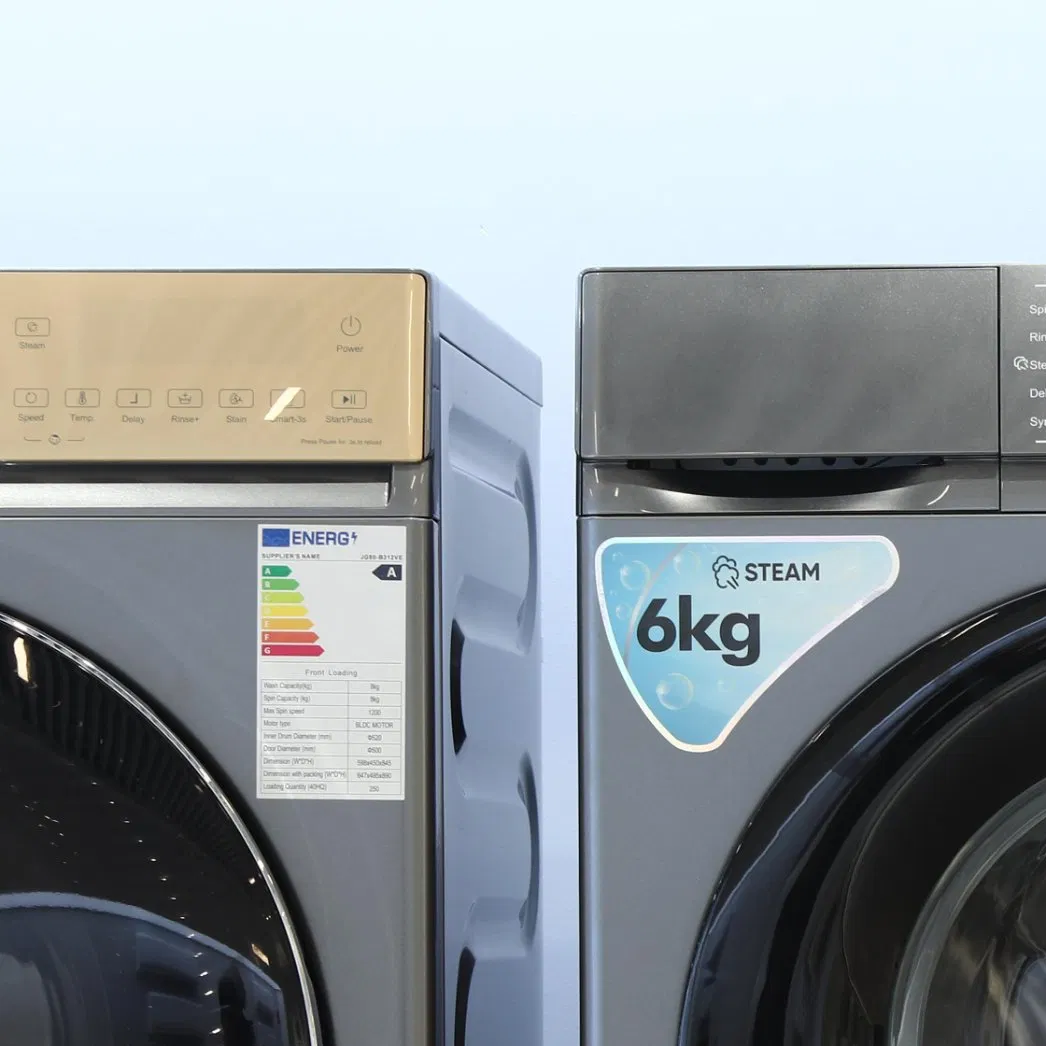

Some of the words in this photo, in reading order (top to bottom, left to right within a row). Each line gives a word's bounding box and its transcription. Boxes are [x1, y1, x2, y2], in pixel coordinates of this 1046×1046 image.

[19, 341, 45, 349] Steam
[336, 344, 364, 353] Power
[18, 413, 44, 423] Speed
[122, 414, 145, 425] Delay
[171, 415, 200, 424] Rinse+
[226, 414, 247, 424] Stain
[325, 414, 373, 424] Start/Pause
[387, 567, 397, 578] A
[745, 562, 820, 582] STEAM
[636, 594, 760, 667] 6kg
[328, 669, 358, 677] Loading
